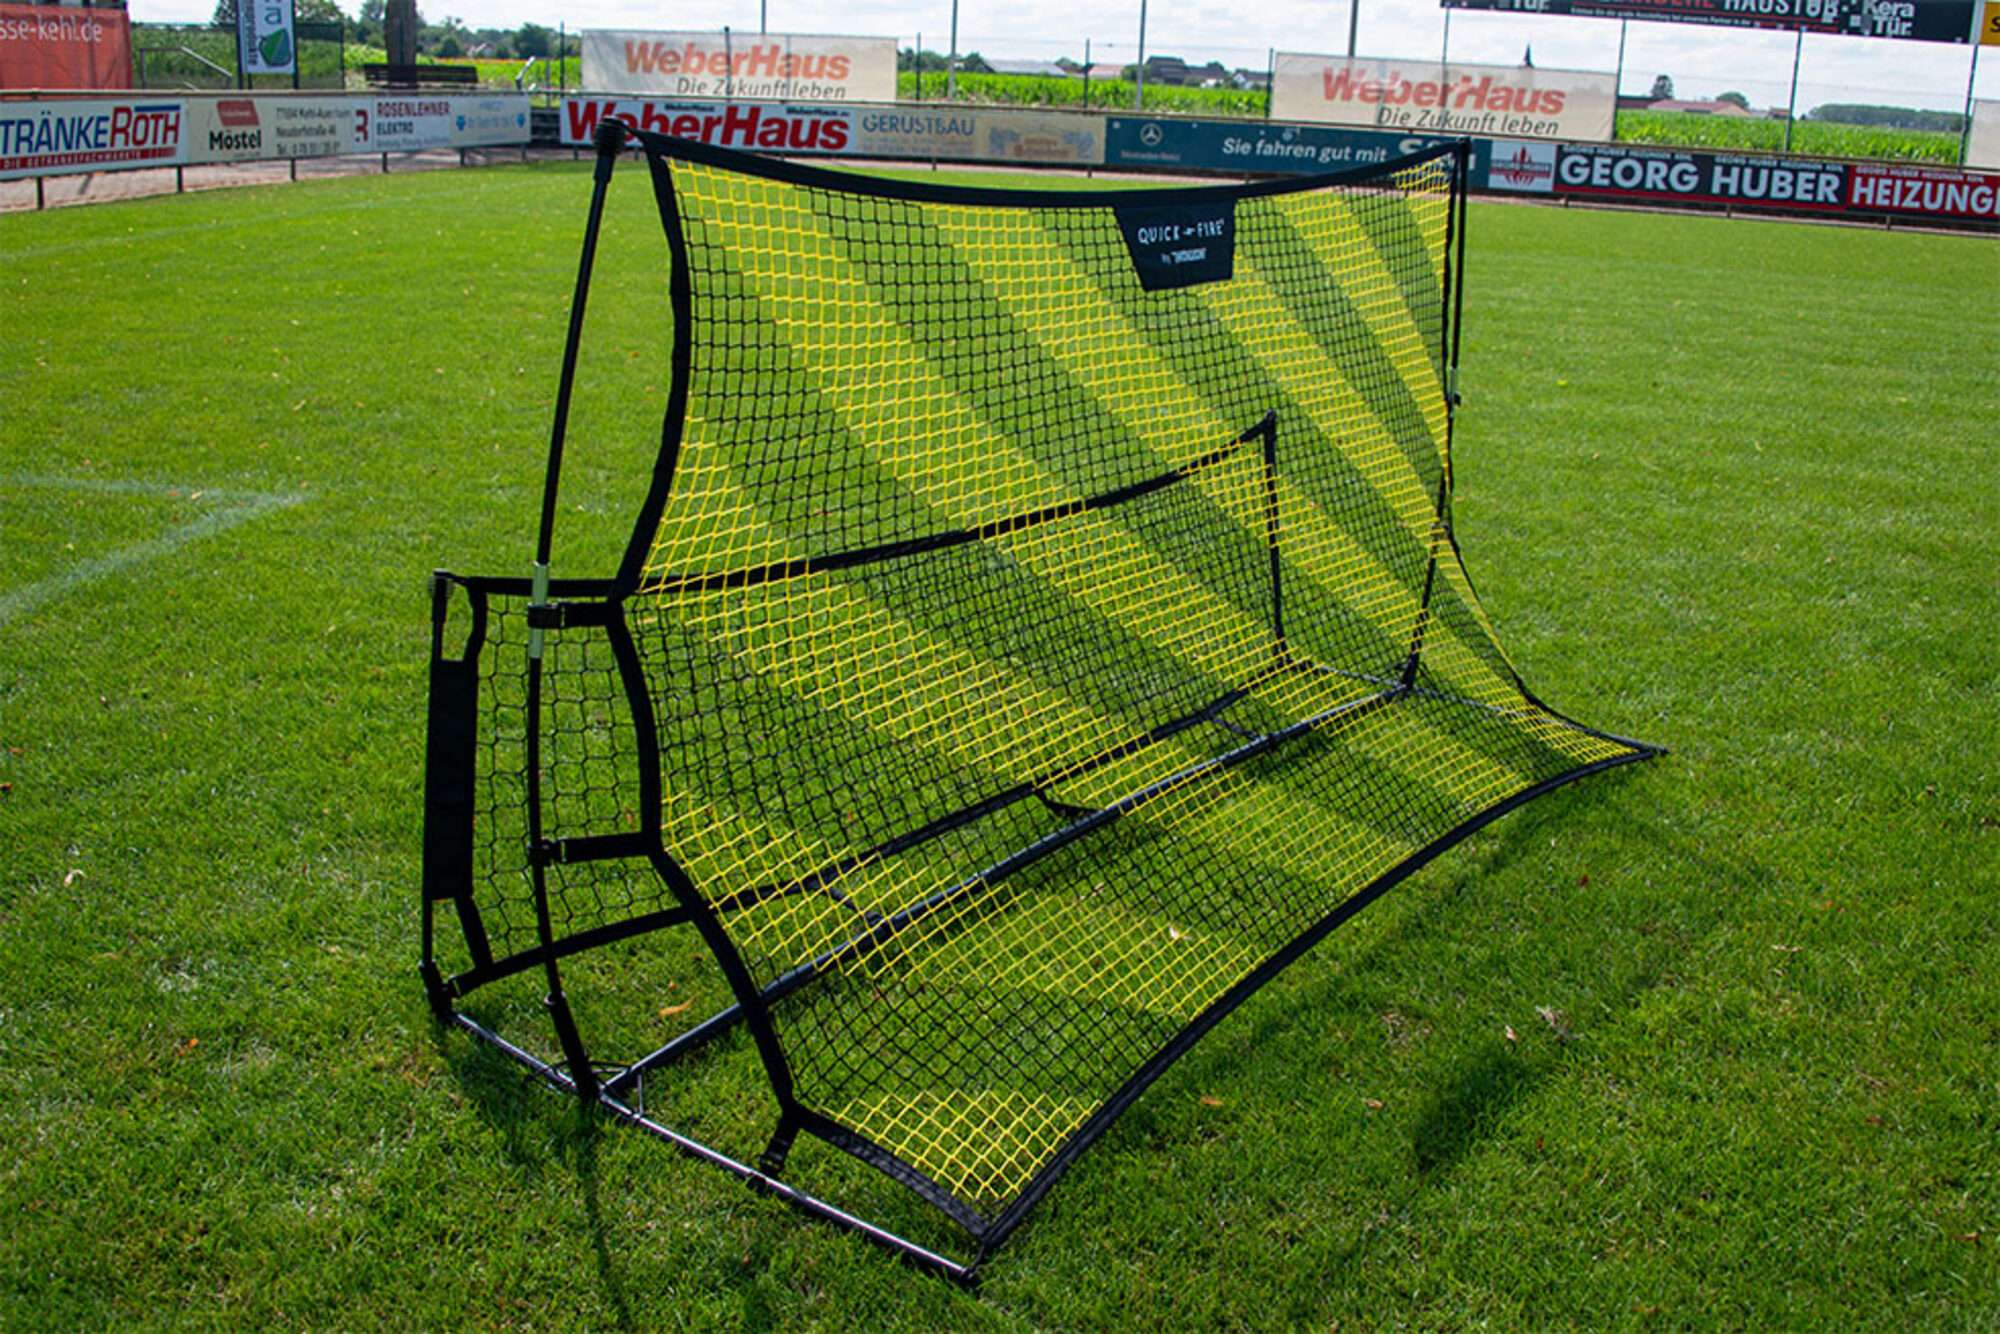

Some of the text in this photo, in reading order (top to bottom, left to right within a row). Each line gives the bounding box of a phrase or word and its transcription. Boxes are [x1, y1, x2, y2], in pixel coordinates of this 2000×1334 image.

[1863, 0, 1915, 17] Kera
[624, 41, 850, 80] WeberHaus
[676, 77, 847, 99] Die Zukunft leben
[1322, 66, 1567, 114] WeberHaus
[1377, 106, 1560, 135] Die Zukunft leben
[209, 129, 262, 151] Möstel
[1222, 137, 1251, 154] Sie
[1255, 139, 1316, 158] fahren
[1318, 145, 1351, 163] gut
[1355, 147, 1388, 163] mit
[1560, 154, 2000, 215] GEORG HUBER HEIZUNG
[1138, 225, 1180, 246] QUICK
